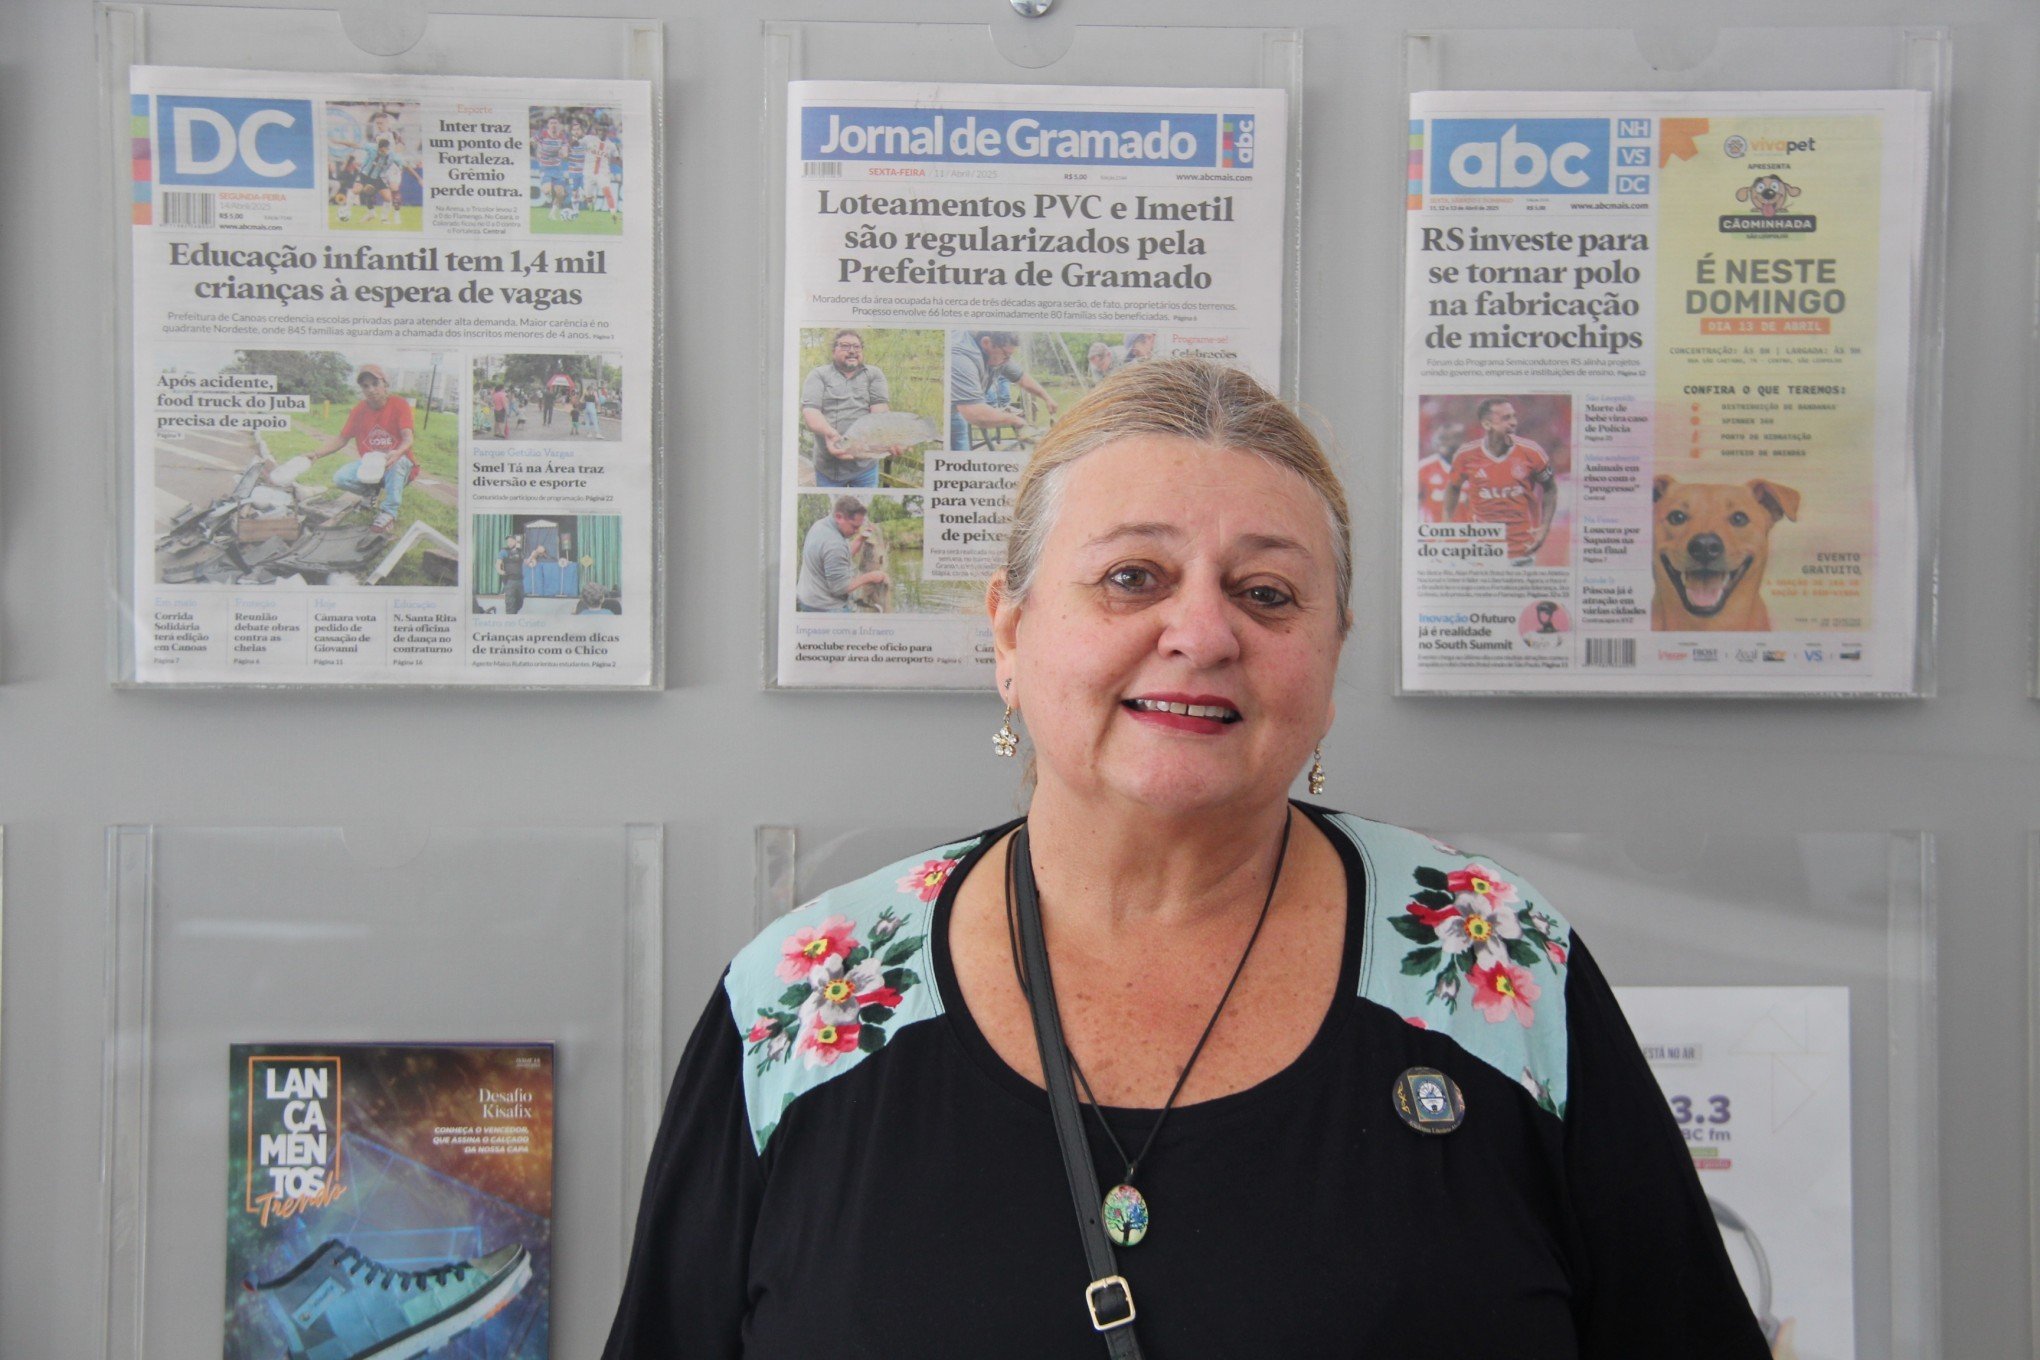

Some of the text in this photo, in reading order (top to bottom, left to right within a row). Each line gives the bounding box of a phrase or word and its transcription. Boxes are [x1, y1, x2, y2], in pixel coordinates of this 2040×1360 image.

[440, 120, 512, 133] Inter traz
[1620, 121, 1648, 136] NH
[172, 105, 298, 180] DC
[430, 137, 522, 151] um ponto de
[820, 115, 1197, 159] Jornal de Gramado
[1234, 120, 1254, 164] abc
[438, 152, 514, 166] Fortaleza.
[1449, 123, 1592, 188] abc
[1621, 148, 1646, 164] VS
[448, 168, 505, 181] Grêmio
[869, 168, 925, 176] SEXTA-FEIRA
[1176, 173, 1253, 181] www.abcmais.com
[430, 184, 523, 198] perde outra.
[1619, 177, 1646, 192] DC
[819, 190, 1234, 222] Loteamentos PVC e Imetil
[218, 223, 282, 231] www.abcmais.com
[1723, 218, 1812, 229] CÃOMINHADA
[844, 224, 1206, 262] são regularizados pela
[1422, 227, 1649, 257] RS investe para
[169, 242, 606, 278] Educação infantil tem 1,4 mil
[839, 257, 1213, 290] Prefeitura de Gramado
[1428, 259, 1641, 290] se tornar polo
[1697, 252, 1836, 284] É NESTE
[194, 275, 583, 311] crianças à espera de vagas
[1429, 290, 1640, 322] na fabricação
[1686, 289, 1846, 314] DOMINGO
[168, 312, 216, 321] Prefeitura
[217, 313, 229, 321] de
[232, 313, 267, 323] Canoas
[268, 314, 314, 323] credencia
[316, 315, 351, 324] escolas
[352, 316, 392, 326] privadas
[394, 318, 415, 327] para
[416, 316, 452, 326] atender
[454, 317, 472, 326] alta
[474, 318, 518, 326] demanda.
[520, 318, 547, 326] Maior
[549, 319, 588, 328] carência
[1708, 321, 1821, 331] DIA 13 DE ABRIL
[1425, 324, 1644, 355] de microchips
[158, 375, 274, 390] Após acidente,
[1684, 386, 1736, 394] CONFIRA
[1758, 386, 1779, 397] QUE
[1788, 386, 1846, 395] TEREMOS:
[158, 394, 306, 411] food truck do Juba
[158, 414, 287, 430] precisa de apoio
[473, 462, 504, 472] Smel
[508, 463, 523, 472] Tá
[545, 461, 575, 473] Área
[578, 466, 604, 474] traz
[935, 460, 1019, 472] Produtores
[473, 476, 527, 487] diversão
[539, 479, 586, 490] esporte
[931, 498, 967, 509] para
[941, 528, 960, 541] de
[1418, 524, 1501, 537] Com show
[1418, 542, 1503, 560] do capitão
[1817, 553, 1860, 562] EVENTO
[1418, 613, 1516, 625] Inovação O futuro
[473, 632, 619, 644] Crianças aprendem dicas
[1419, 627, 1428, 637] já
[1440, 626, 1492, 637] realidade
[472, 645, 486, 654] de
[490, 645, 535, 654] trânsito
[575, 645, 608, 655] Chico
[797, 642, 932, 654] Aeroclube recebe ofício para
[1435, 640, 1468, 649] South
[1470, 640, 1513, 650] Summit
[796, 653, 934, 665] desocupar área do aeroporto
[1805, 650, 1822, 662] VS
[1667, 1047, 1680, 1059] NO
[1682, 1047, 1695, 1059] AR
[266, 1067, 327, 1099] LAN
[480, 1089, 532, 1103] Desafio
[483, 1104, 531, 1118] Kisafix
[434, 1127, 473, 1135] CONHEÇA
[484, 1126, 529, 1136] VENCEDOR,
[433, 1137, 450, 1145] QUE
[490, 1136, 529, 1145] CALÇADO
[260, 1134, 327, 1166] MEN
[269, 1166, 326, 1199] TOS
